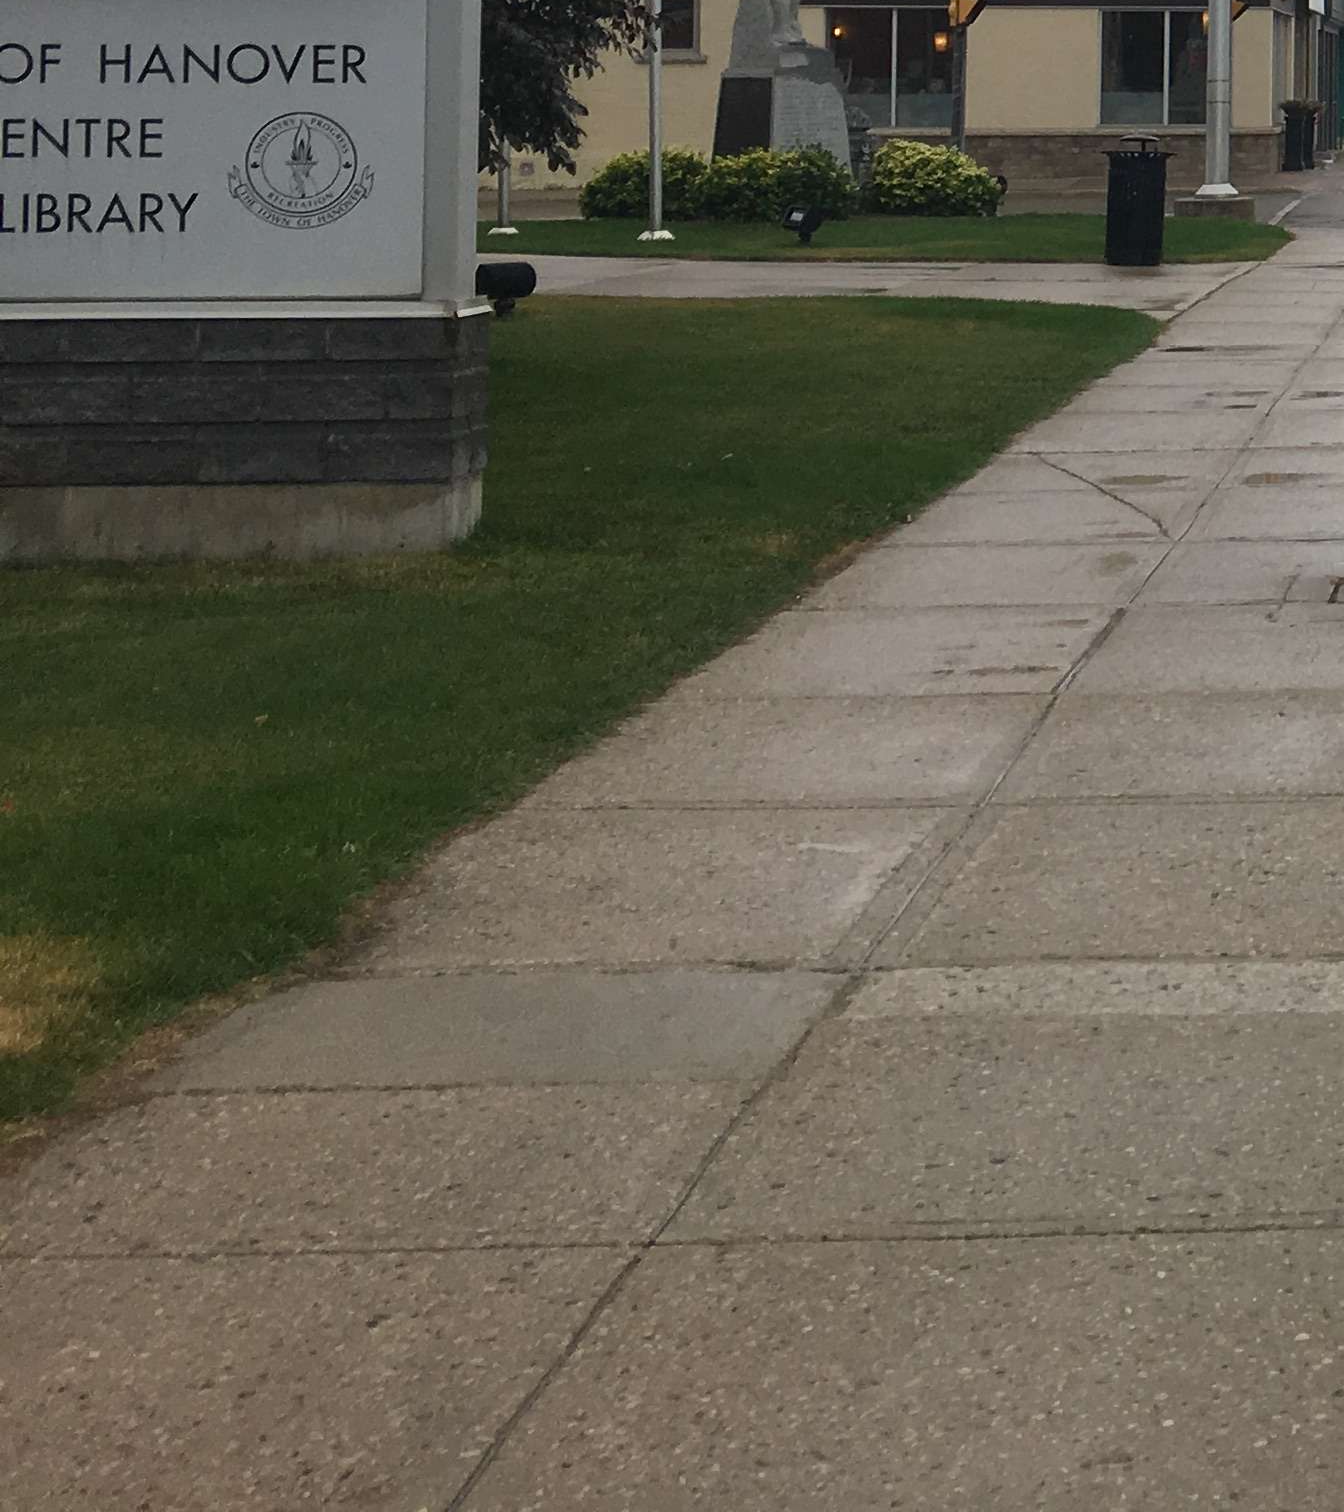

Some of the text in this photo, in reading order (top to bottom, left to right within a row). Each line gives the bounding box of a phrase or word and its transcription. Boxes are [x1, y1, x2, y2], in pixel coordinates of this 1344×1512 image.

[0, 43, 367, 85] OF HANOVER
[2, 118, 163, 158] ENTRE
[0, 193, 199, 233] LIBRARY
